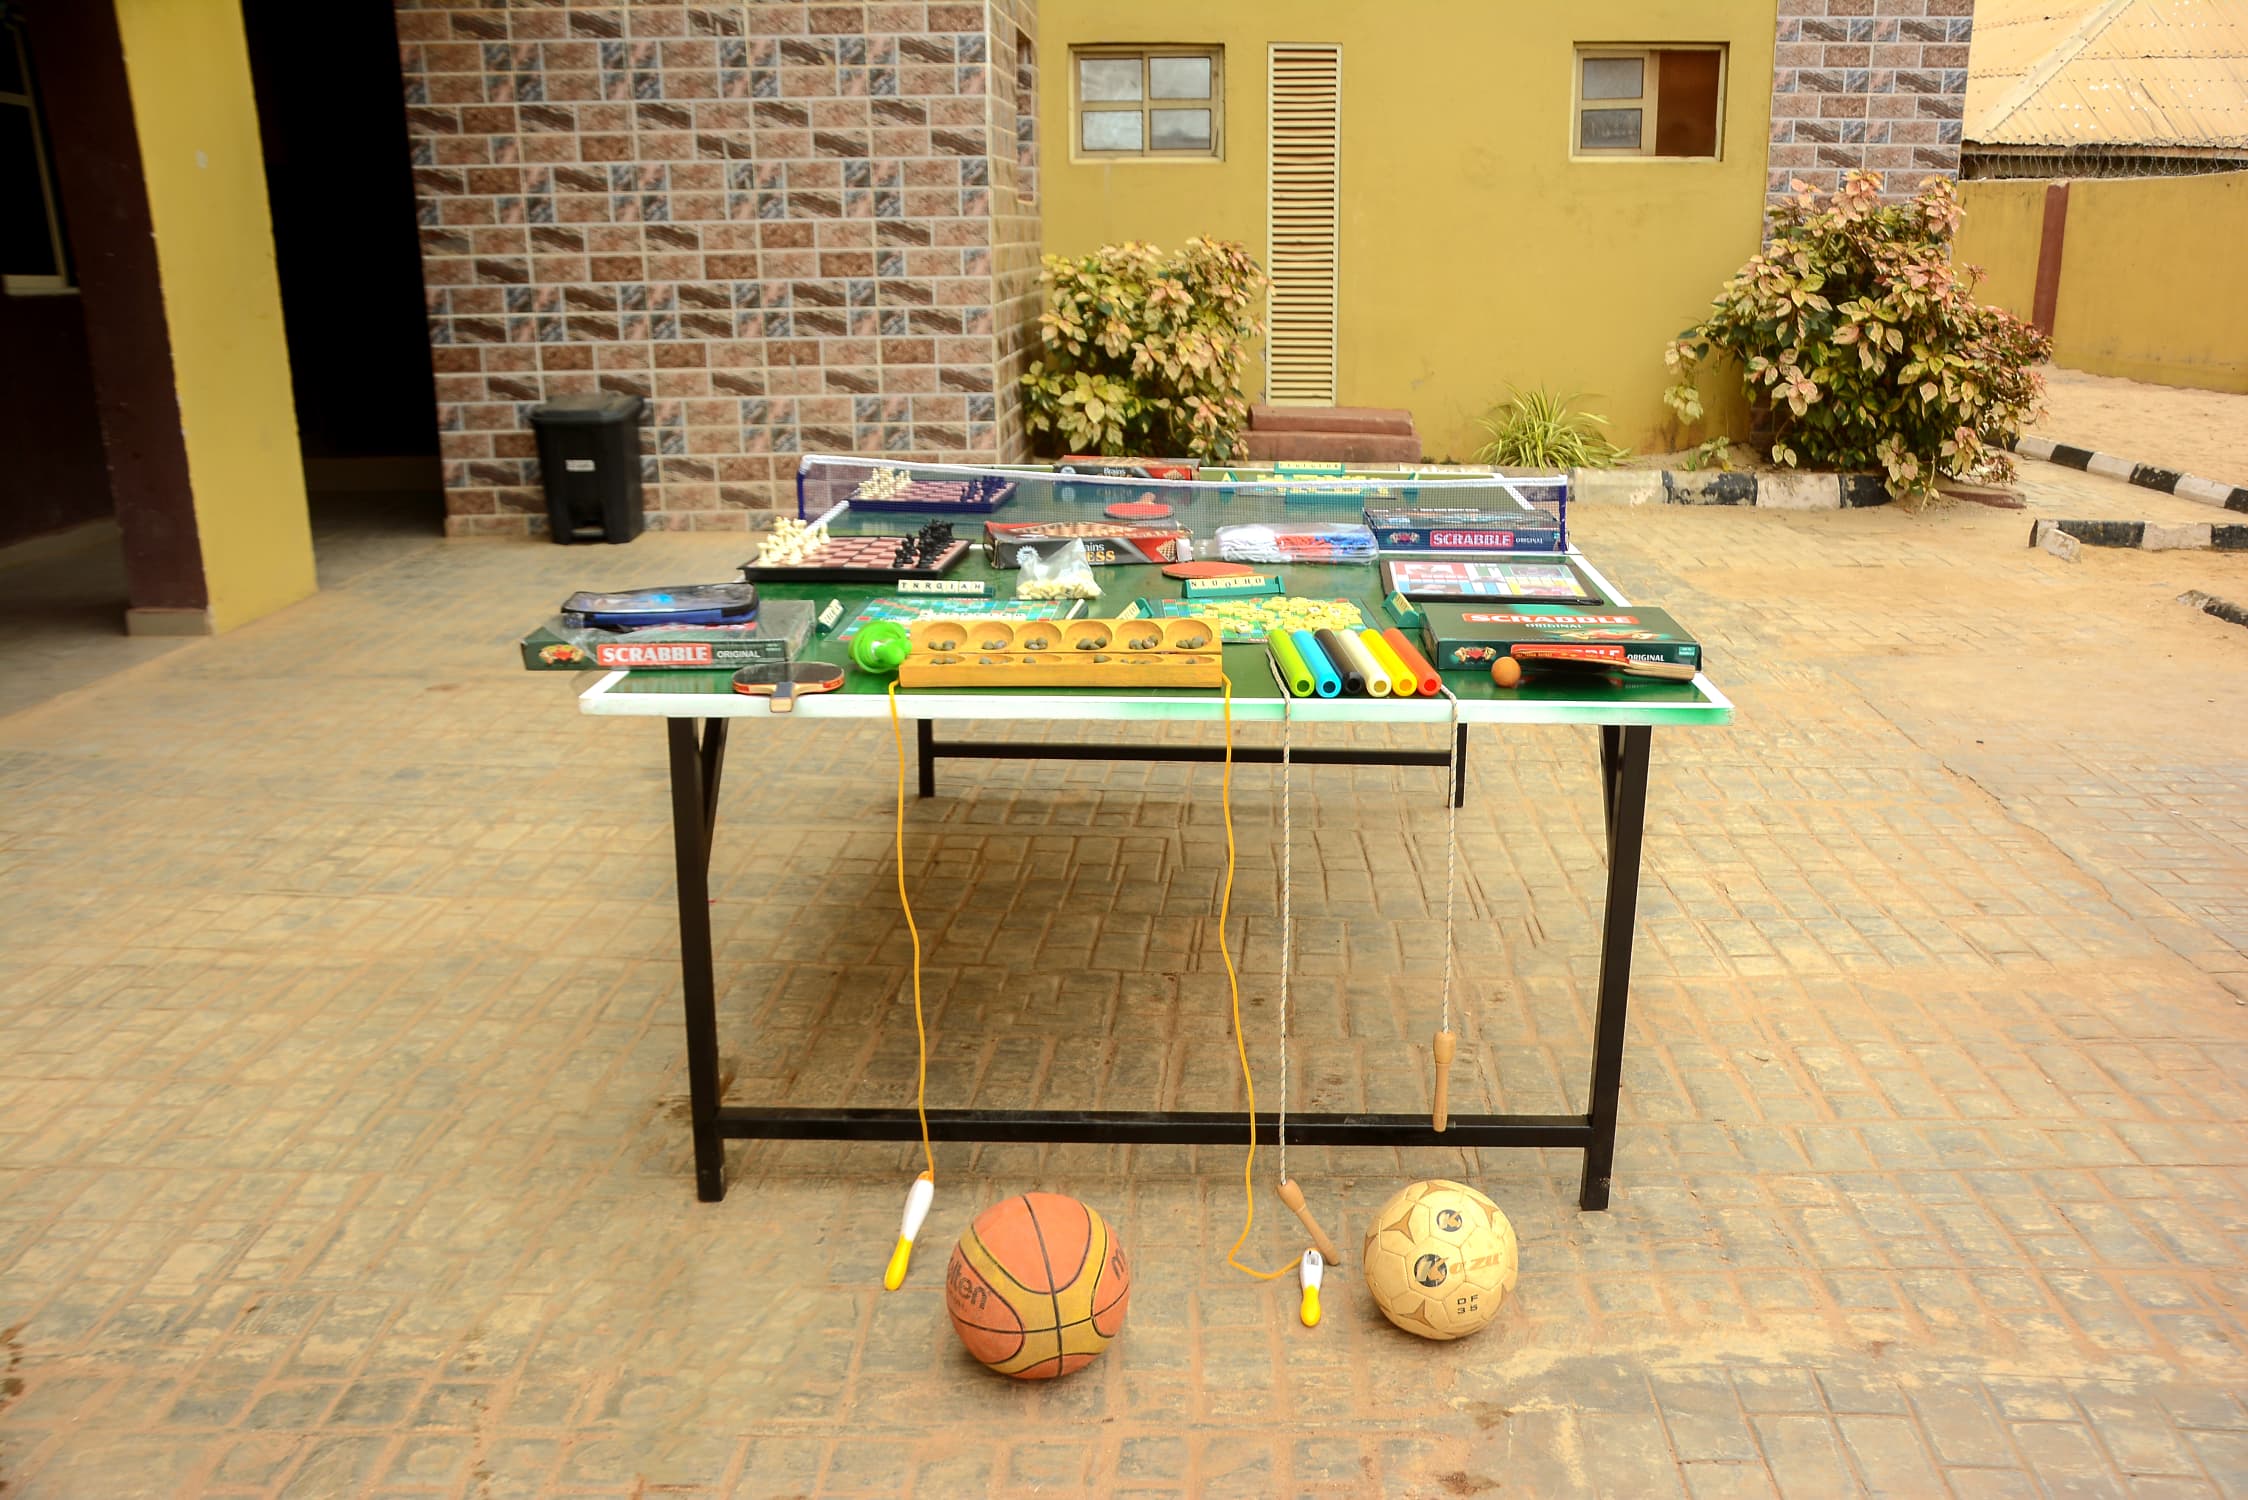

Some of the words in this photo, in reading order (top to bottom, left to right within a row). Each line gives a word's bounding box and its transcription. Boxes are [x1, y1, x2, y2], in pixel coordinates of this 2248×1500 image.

[1103, 467, 1126, 475] Brains
[1433, 532, 1511, 546] SCRABBLE
[1086, 550, 1116, 562] ESS
[1471, 613, 1633, 625] SCRABBLE
[602, 645, 708, 663] SCRABBLE
[716, 650, 761, 659] ORIGINAL
[1627, 653, 1665, 662] ORIGINAL
